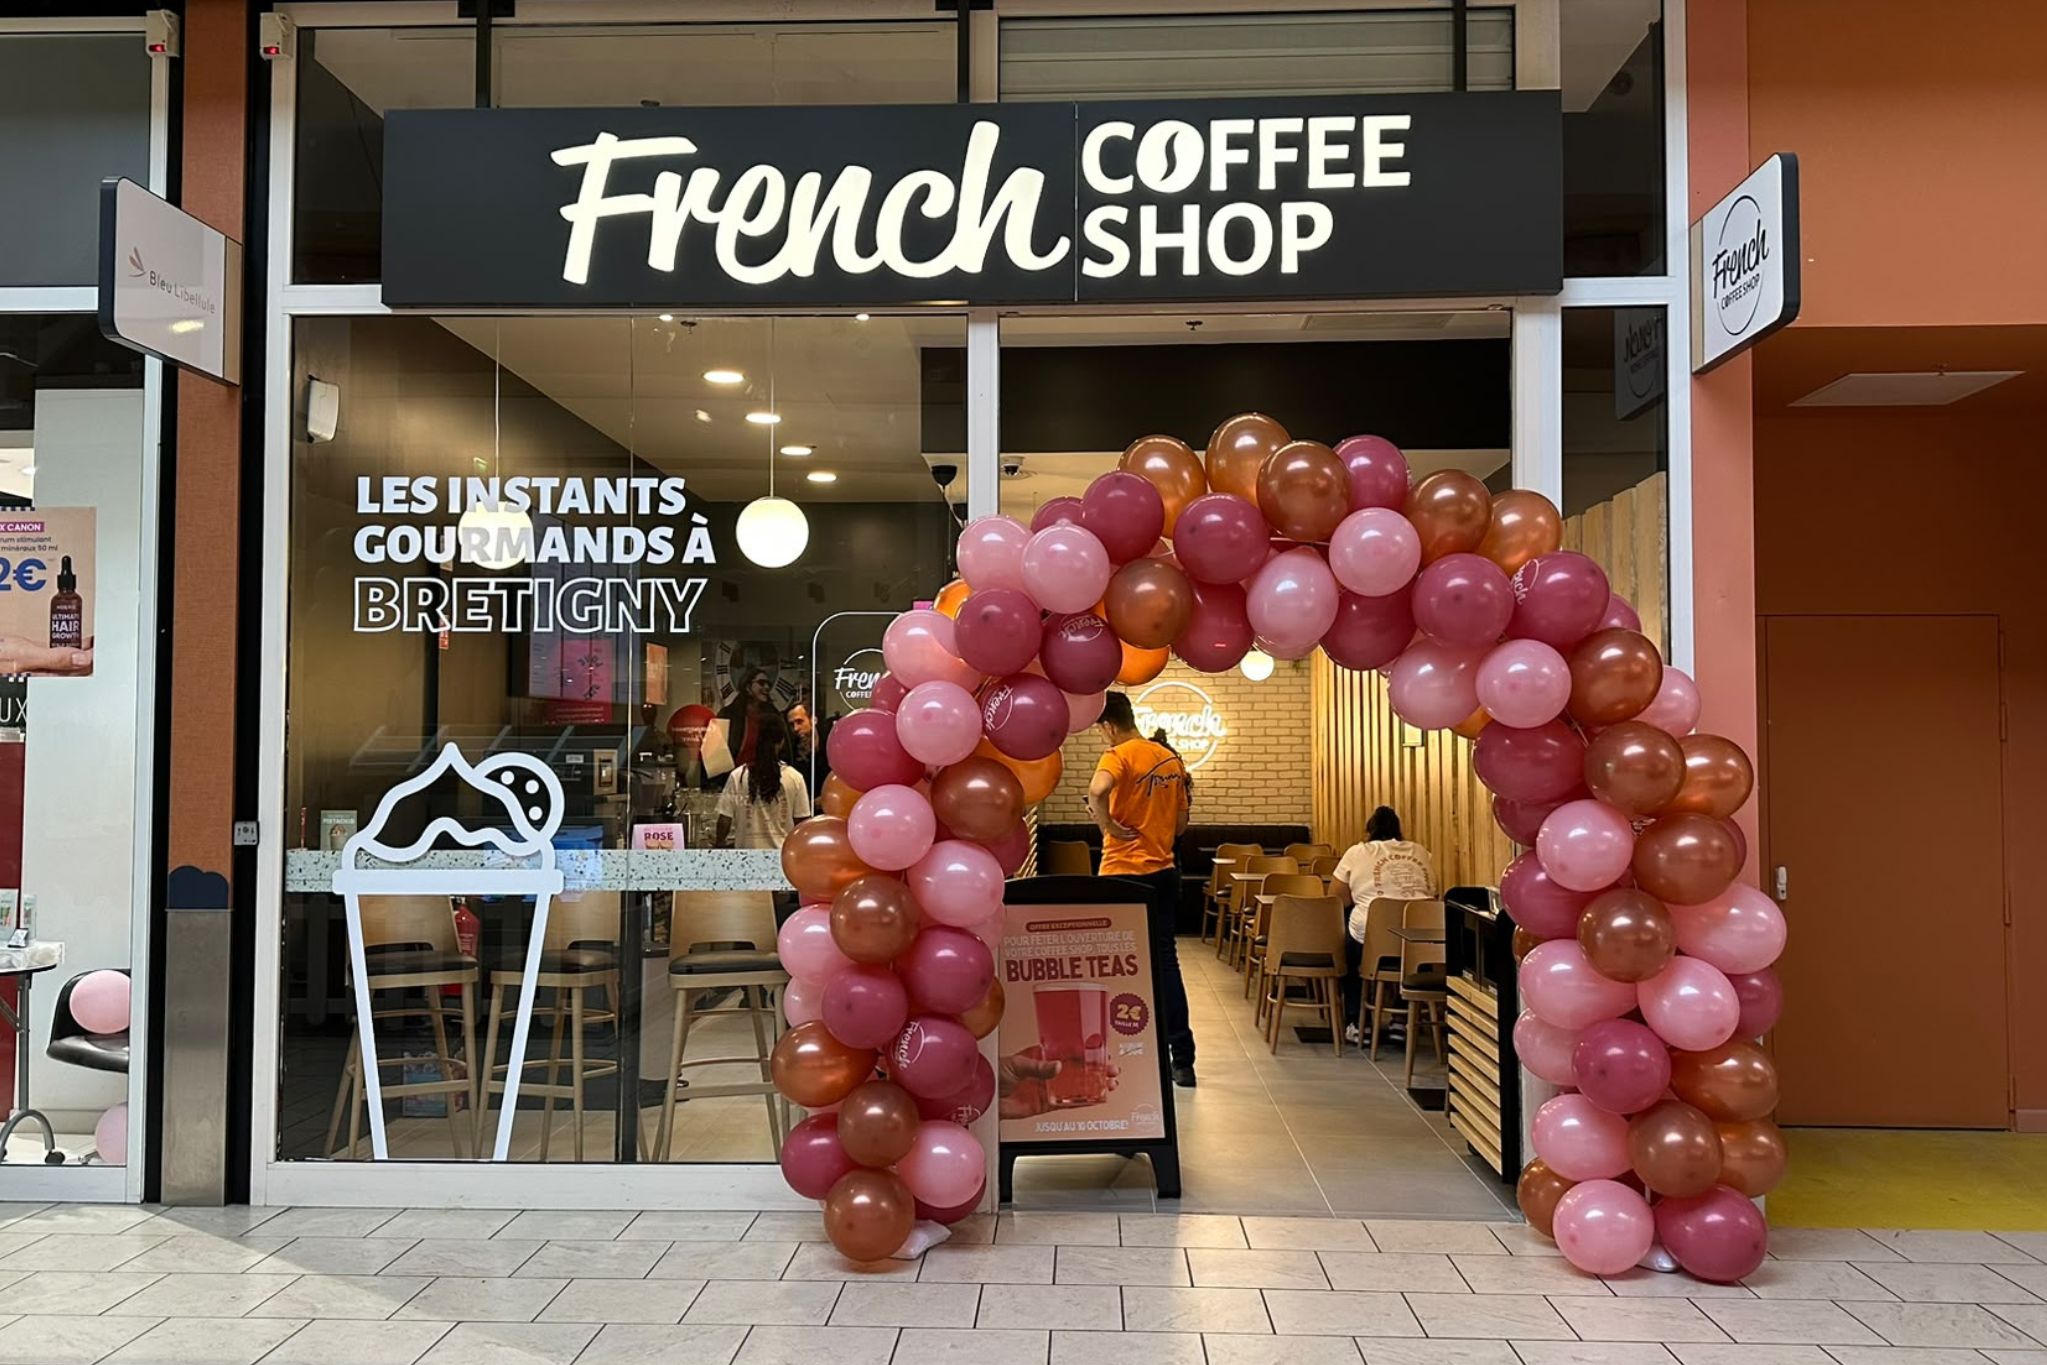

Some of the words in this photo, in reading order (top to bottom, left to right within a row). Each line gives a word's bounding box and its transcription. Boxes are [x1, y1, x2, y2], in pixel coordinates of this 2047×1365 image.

[1082, 115, 1411, 194] COFFEE
[550, 120, 1070, 284] French
[1082, 202, 1333, 278] SHOP
[1712, 218, 1770, 299] French
[149, 269, 173, 295] Bleu
[174, 281, 216, 315] Libellule
[1721, 285, 1742, 311] COFFEE
[1742, 272, 1760, 296] SHOP
[356, 476, 438, 514] LES
[448, 477, 686, 515] INSTANTS
[7, 523, 41, 532] CANON
[354, 525, 675, 563] GOURMANDS
[682, 512, 716, 564] À
[0, 557, 47, 592] 2€
[353, 577, 707, 633] BRETIGNY
[51, 620, 80, 632] HAIR
[833, 667, 881, 690] Fren
[984, 685, 1014, 731] French
[644, 831, 674, 841] ROSE
[1003, 935, 1029, 946] POUR
[1122, 930, 1135, 941] DE
[1004, 947, 1033, 957] VOTRE
[1035, 945, 1068, 956] COFFEE
[1096, 943, 1119, 953] TOUS
[1120, 942, 1137, 952] LES
[1006, 957, 1083, 982] BUBBLE
[1085, 954, 1138, 978] TEAS
[1116, 1003, 1142, 1020] 2€
[897, 1021, 920, 1069] French
